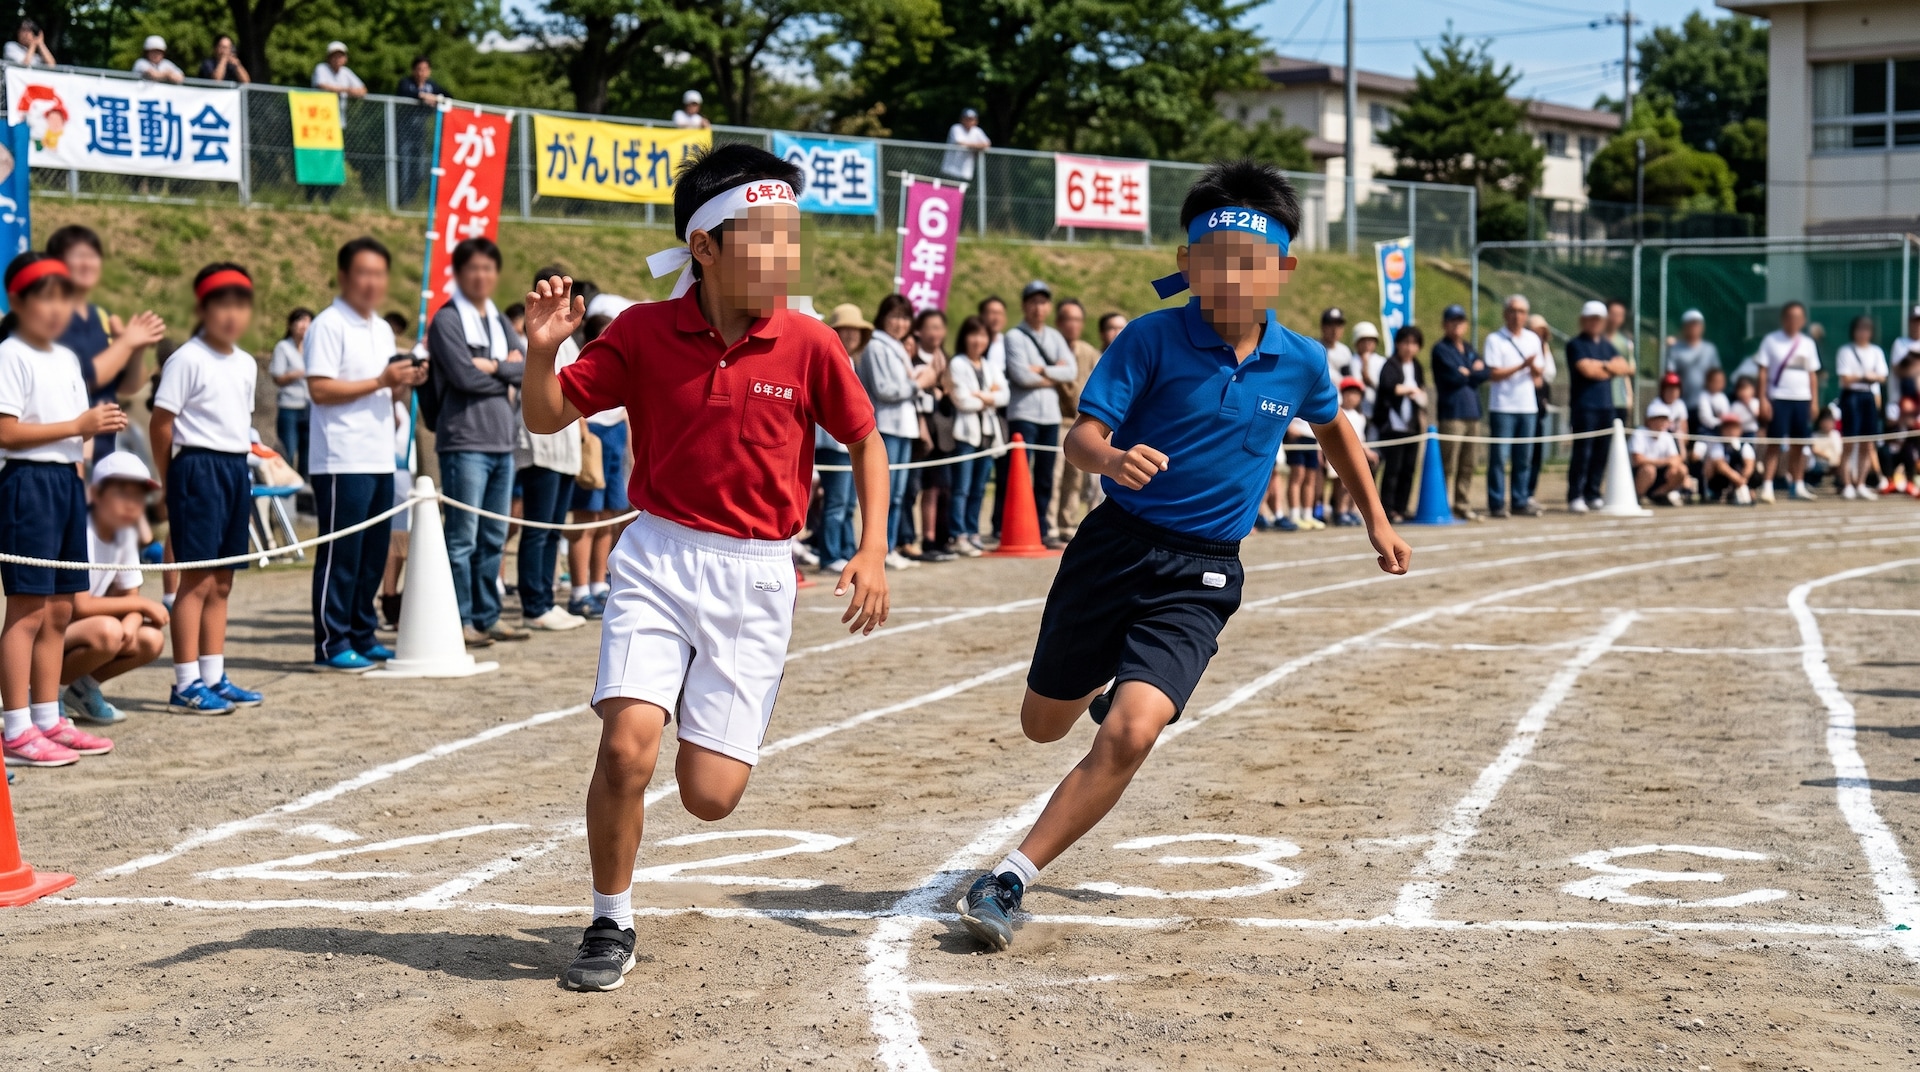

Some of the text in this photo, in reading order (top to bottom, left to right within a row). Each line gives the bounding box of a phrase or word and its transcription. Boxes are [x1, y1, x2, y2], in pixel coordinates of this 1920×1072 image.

[86, 95, 230, 163] 運動会
[546, 132, 701, 188] がんばれ
[443, 123, 496, 295] がんば
[1068, 170, 1141, 215] 6年生
[1207, 210, 1267, 234] 6年2組
[908, 196, 949, 319] 6年生
[753, 382, 793, 400] 6年2組
[632, 829, 857, 889] 2
[1076, 833, 1306, 899] 3
